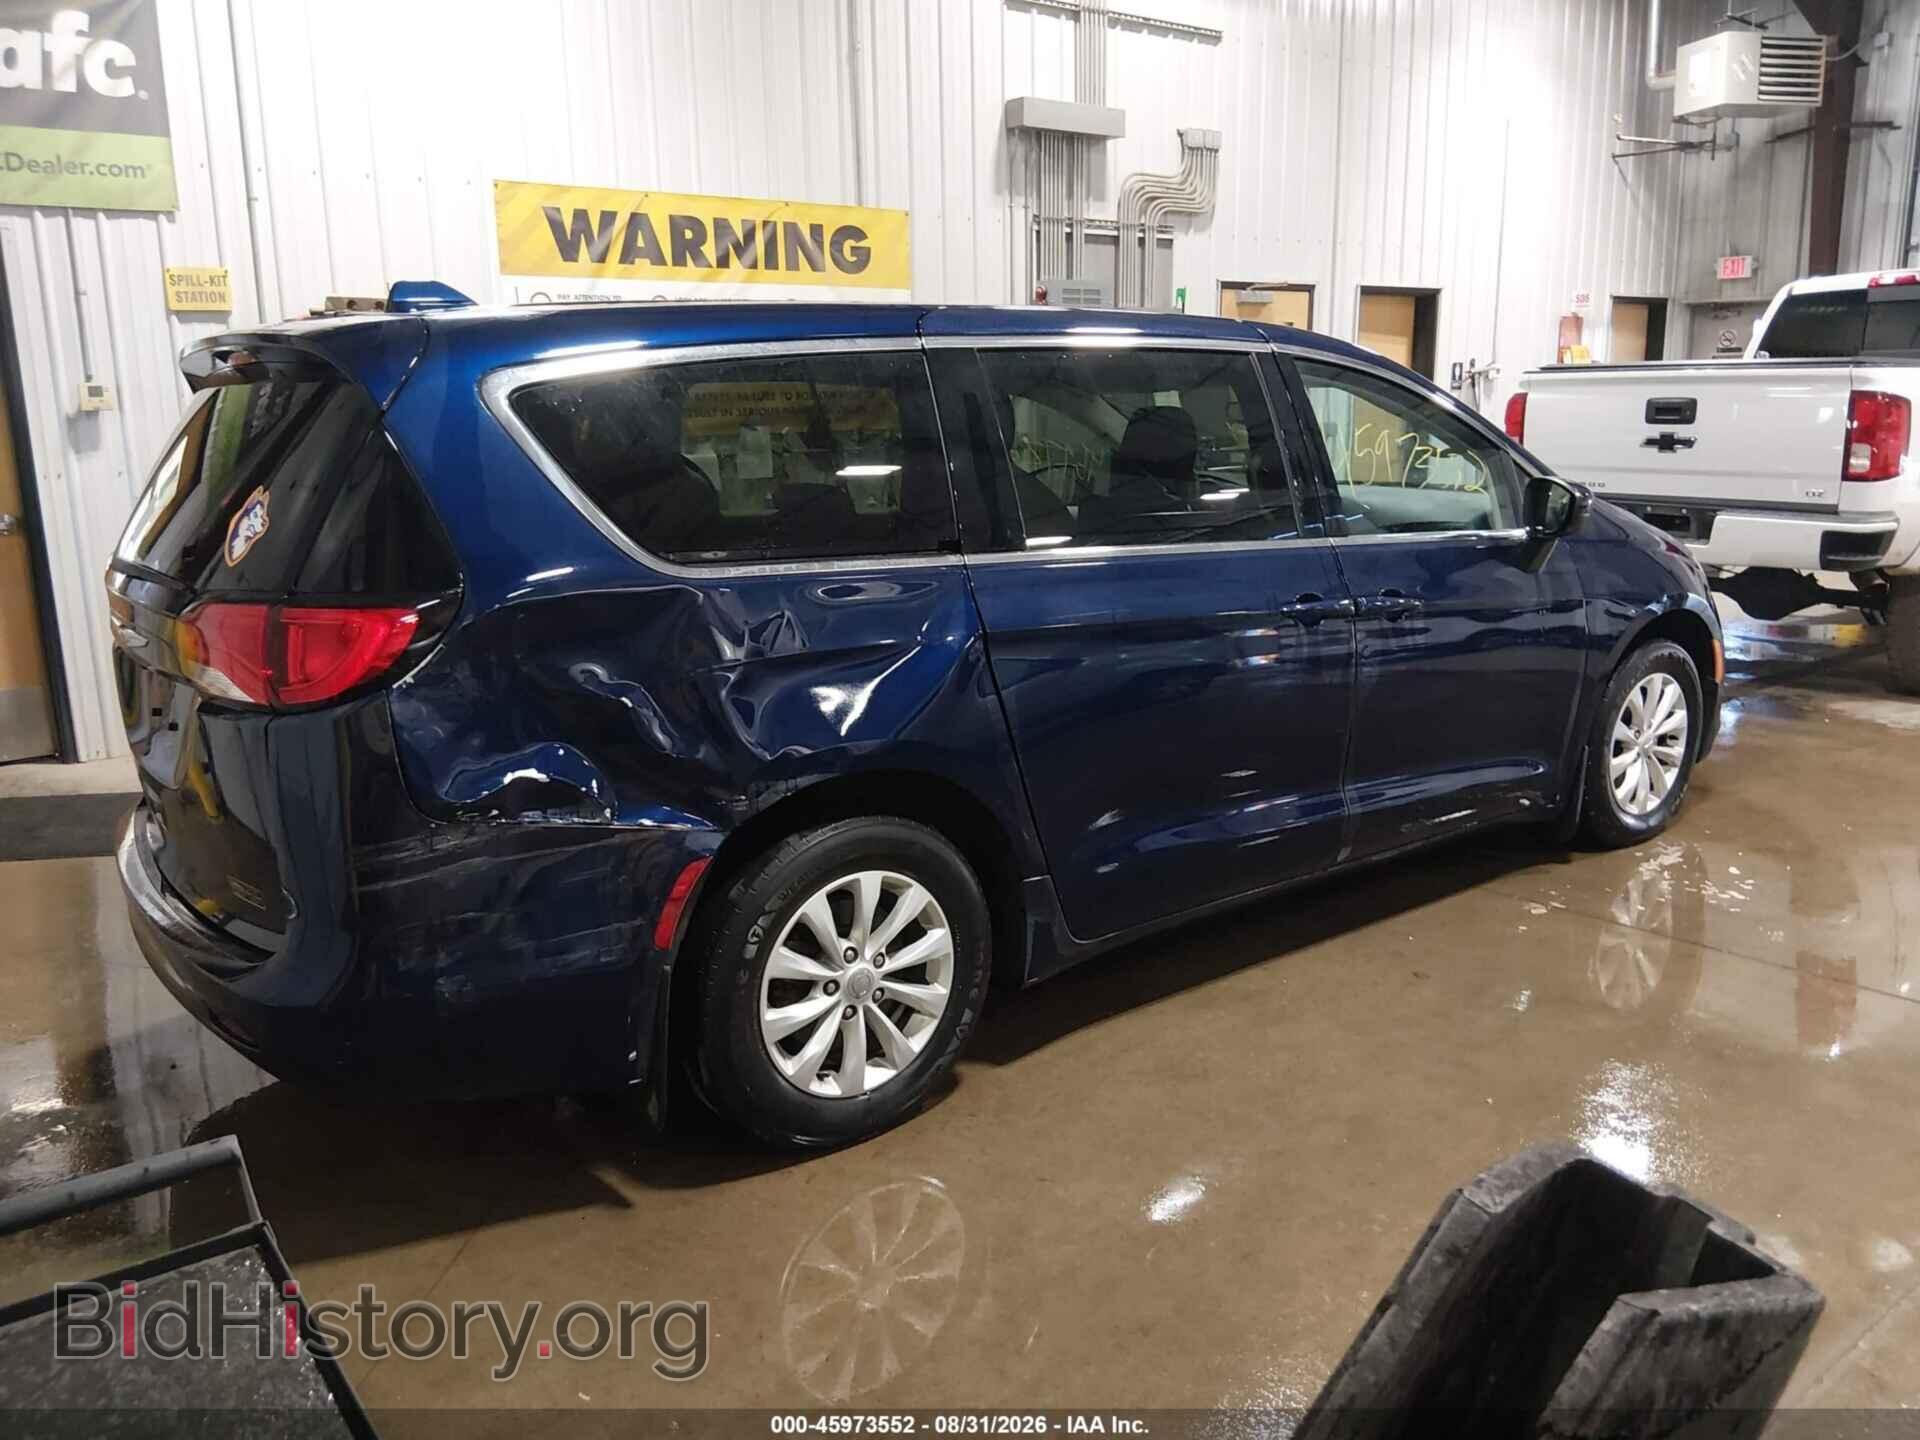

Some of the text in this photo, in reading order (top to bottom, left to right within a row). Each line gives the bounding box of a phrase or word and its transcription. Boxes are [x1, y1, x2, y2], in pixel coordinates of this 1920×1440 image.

[0, 152, 146, 179] Dealer.com
[542, 206, 872, 275] WARNING
[1722, 257, 1746, 277] EXIT
[169, 274, 228, 287] SPILL-KIT
[176, 290, 226, 304] STATION
